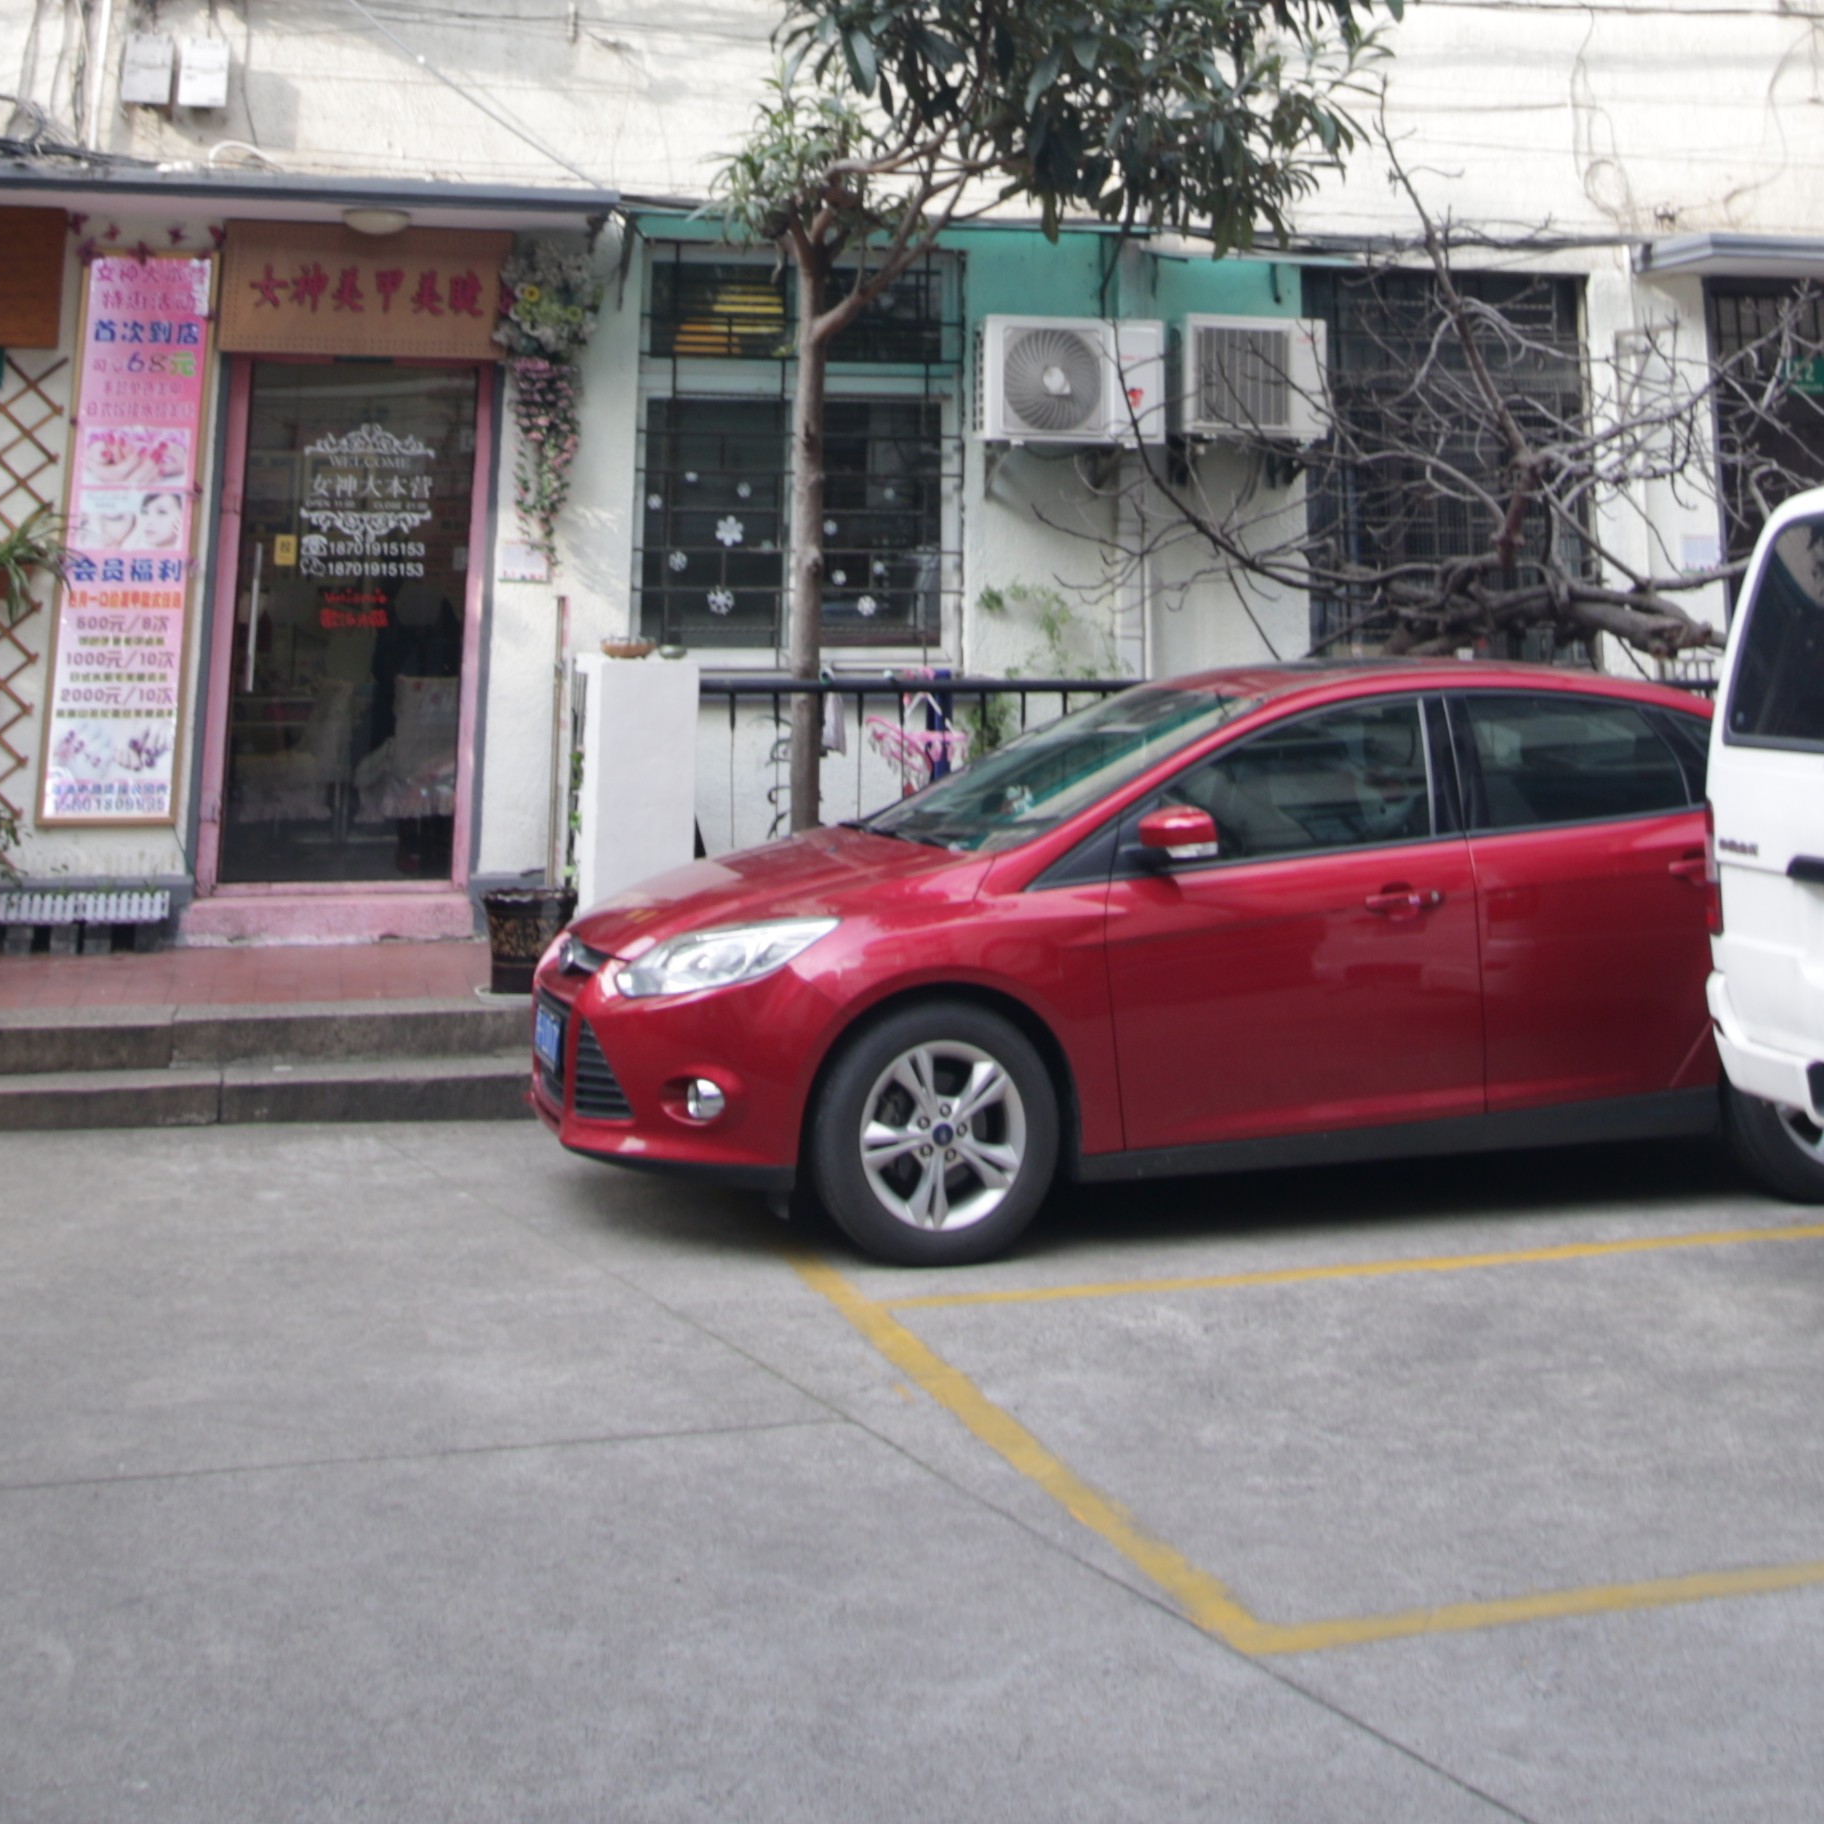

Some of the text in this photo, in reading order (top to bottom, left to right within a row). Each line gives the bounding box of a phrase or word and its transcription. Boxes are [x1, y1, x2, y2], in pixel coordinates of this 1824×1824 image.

[94, 319, 199, 345] 首次到店
[72, 558, 182, 582] 会员福利
